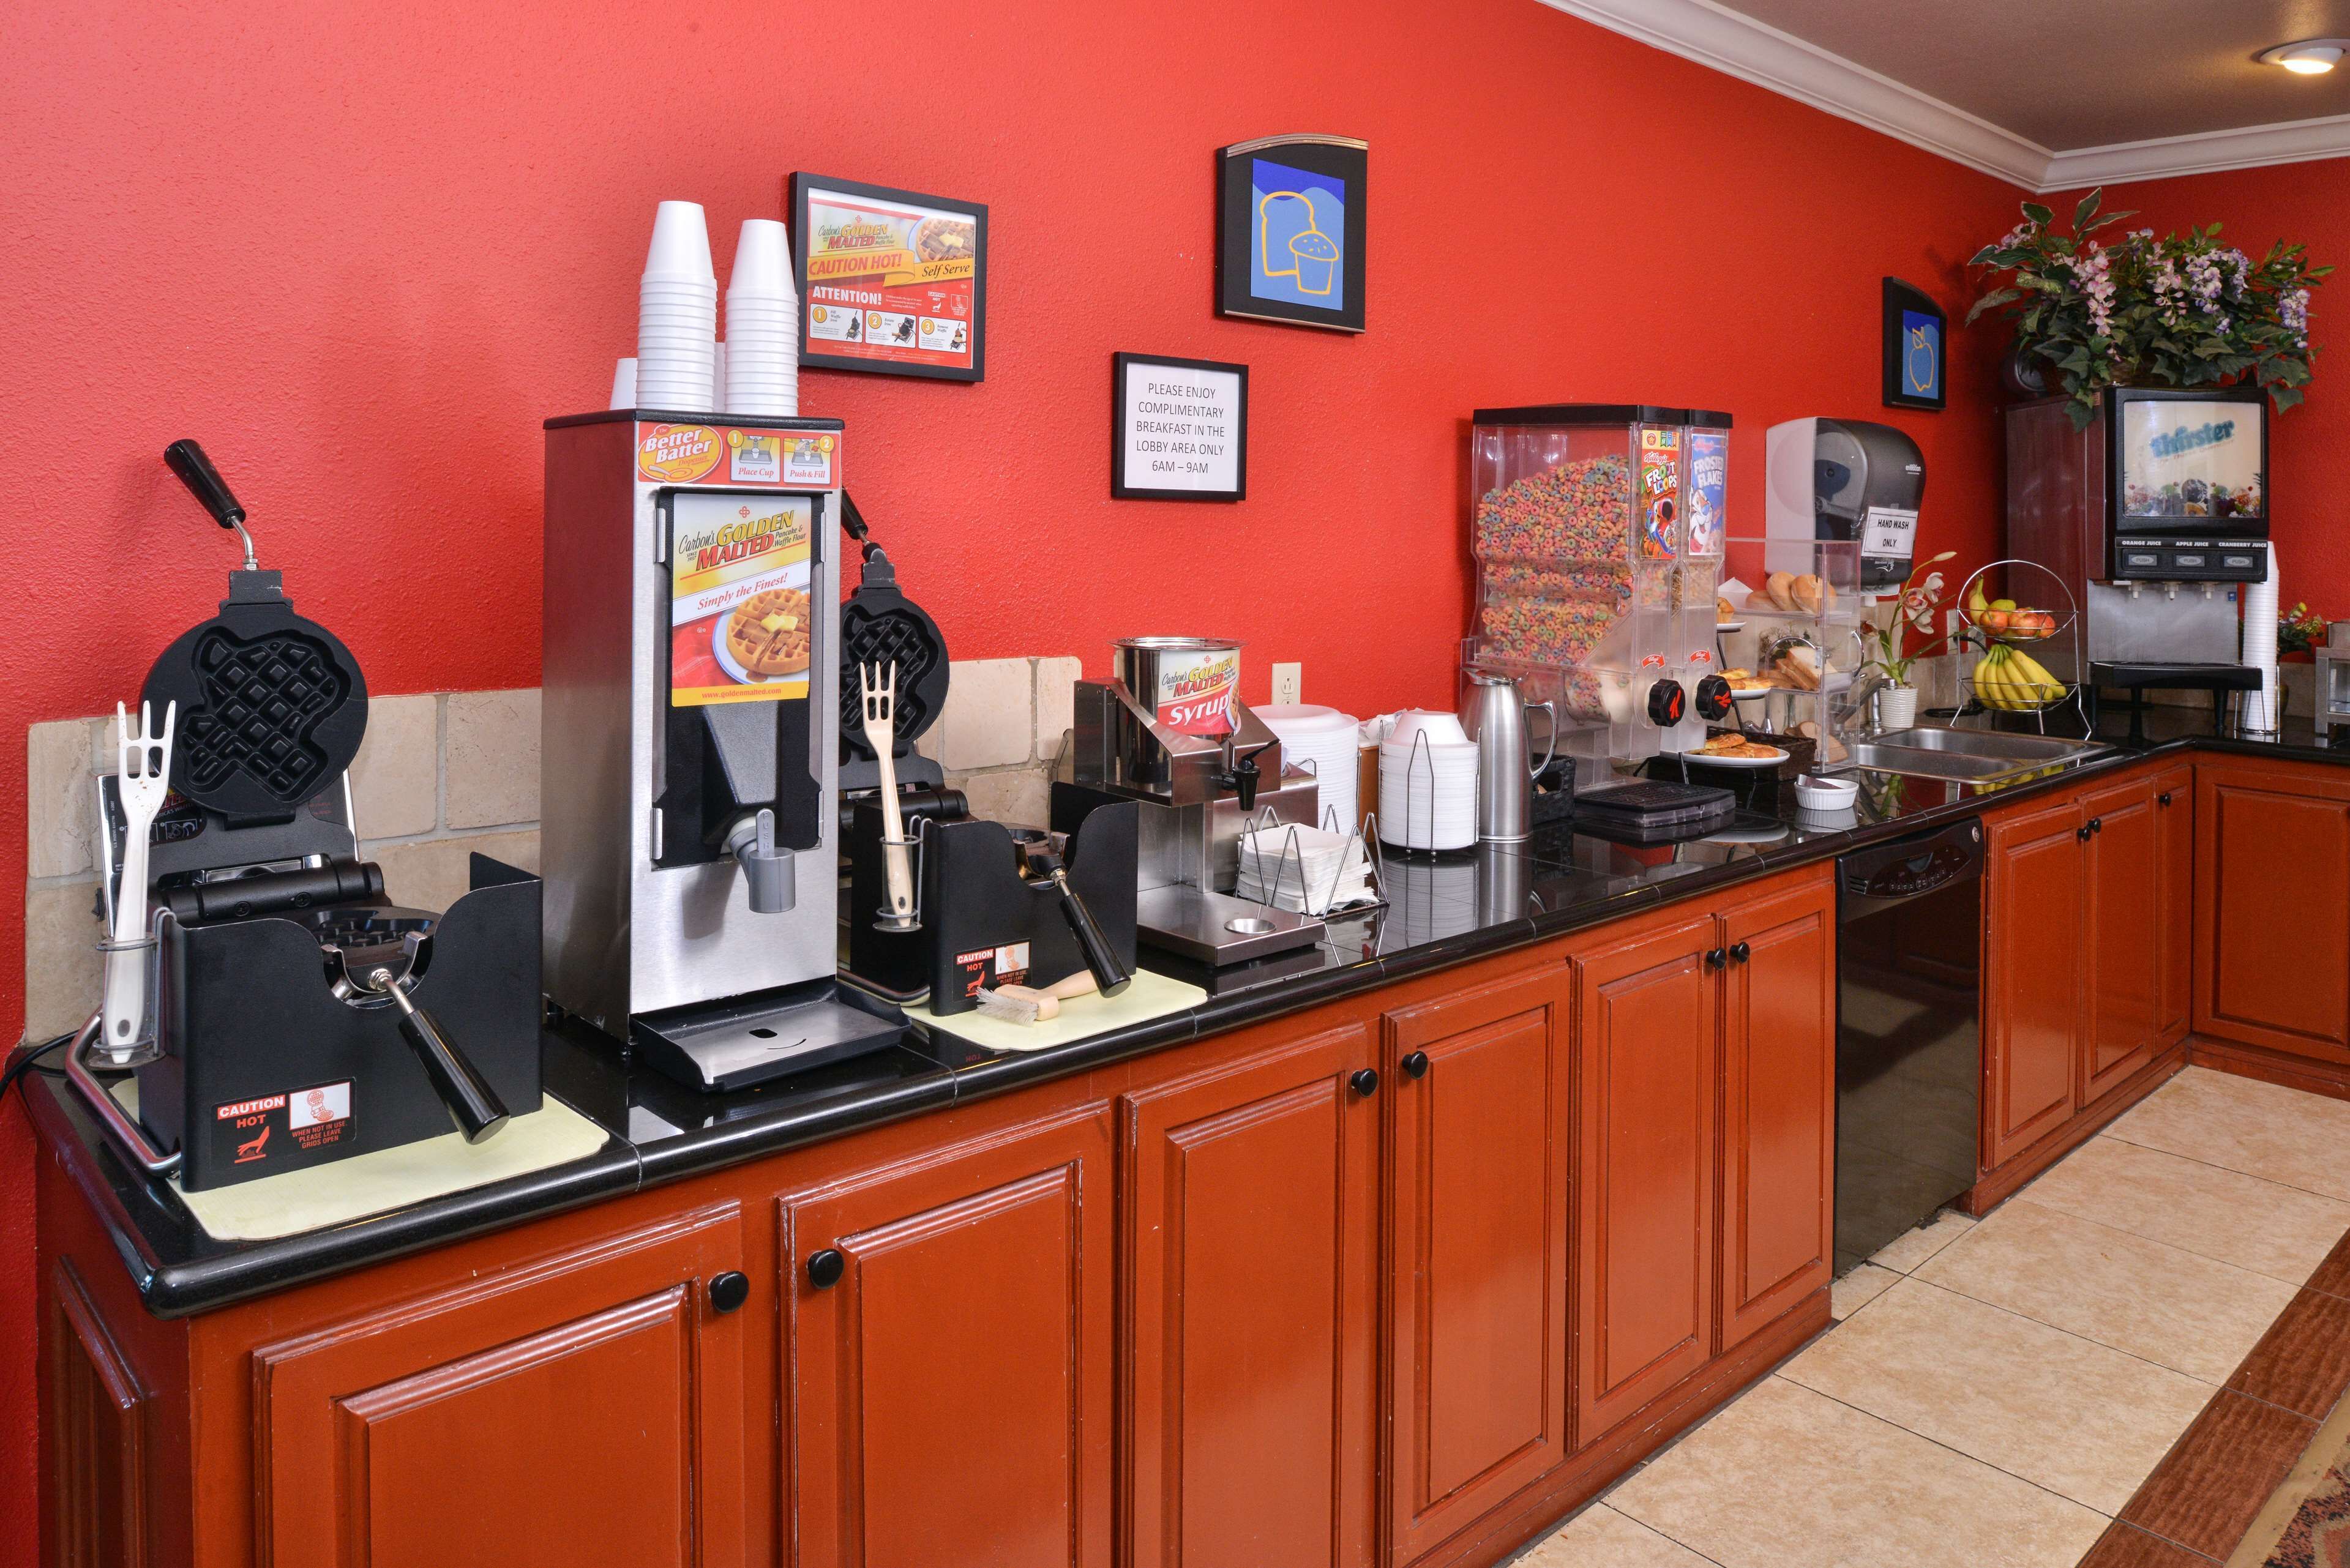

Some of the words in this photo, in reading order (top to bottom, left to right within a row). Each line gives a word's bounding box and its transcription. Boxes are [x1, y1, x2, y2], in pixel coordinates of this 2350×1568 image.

[840, 224, 888, 237] GOLDEN
[827, 235, 876, 249] MALTED
[808, 256, 868, 275] CAUTION
[871, 253, 902, 270] HOT!
[922, 264, 944, 278] Self
[943, 264, 970, 274] Serve
[812, 285, 881, 305] ATTENTION!
[817, 308, 822, 319] 1
[872, 316, 877, 325] 2
[925, 323, 930, 332] 3
[1148, 383, 1183, 397] PLEASE
[1186, 386, 1216, 399] ENJOY
[1138, 401, 1224, 418] COMPLIMENTARY
[1136, 420, 1192, 435] BREAKFAST
[1194, 425, 1204, 436] IN
[1207, 425, 1224, 437] THE
[645, 429, 703, 453] Better
[733, 433, 738, 443] 1
[823, 439, 830, 449] 2
[656, 440, 712, 464] Batter
[1136, 440, 1168, 452] LOBBY
[1171, 442, 1196, 454] AREA
[1199, 444, 1224, 455] ONLY
[738, 467, 758, 476] Place
[759, 468, 774, 478] Cup
[1152, 460, 1175, 472] 6AM
[1186, 462, 1208, 474] 9AM
[717, 510, 795, 547] GOLDEN
[1877, 519, 1892, 528] HAND
[1893, 520, 1909, 530] WASH
[774, 536, 792, 548] Waffle
[793, 532, 806, 542] Flour
[776, 527, 798, 539] Pancake
[1882, 538, 1897, 547] ONLY
[696, 533, 774, 571] MALTED
[697, 591, 734, 610] Simply
[736, 586, 752, 598] the
[754, 572, 788, 592] Finest!
[1162, 671, 1187, 686] Carbon's
[1188, 656, 1233, 682] GOLDEN
[1173, 673, 1224, 697] MALTED
[702, 689, 782, 698] www.goldenmalted.com
[1168, 693, 1230, 726] Syrup
[957, 950, 993, 963] CAUTION
[967, 963, 983, 971] HOT
[219, 1096, 284, 1118] CAUTION
[236, 1114, 266, 1129] HOT
[292, 1128, 310, 1137] WHEN
[299, 1132, 322, 1143] PLEASE
[324, 1128, 342, 1137] LEAVE
[301, 1139, 321, 1149] GRIDS
[323, 1135, 339, 1144] OPEN
